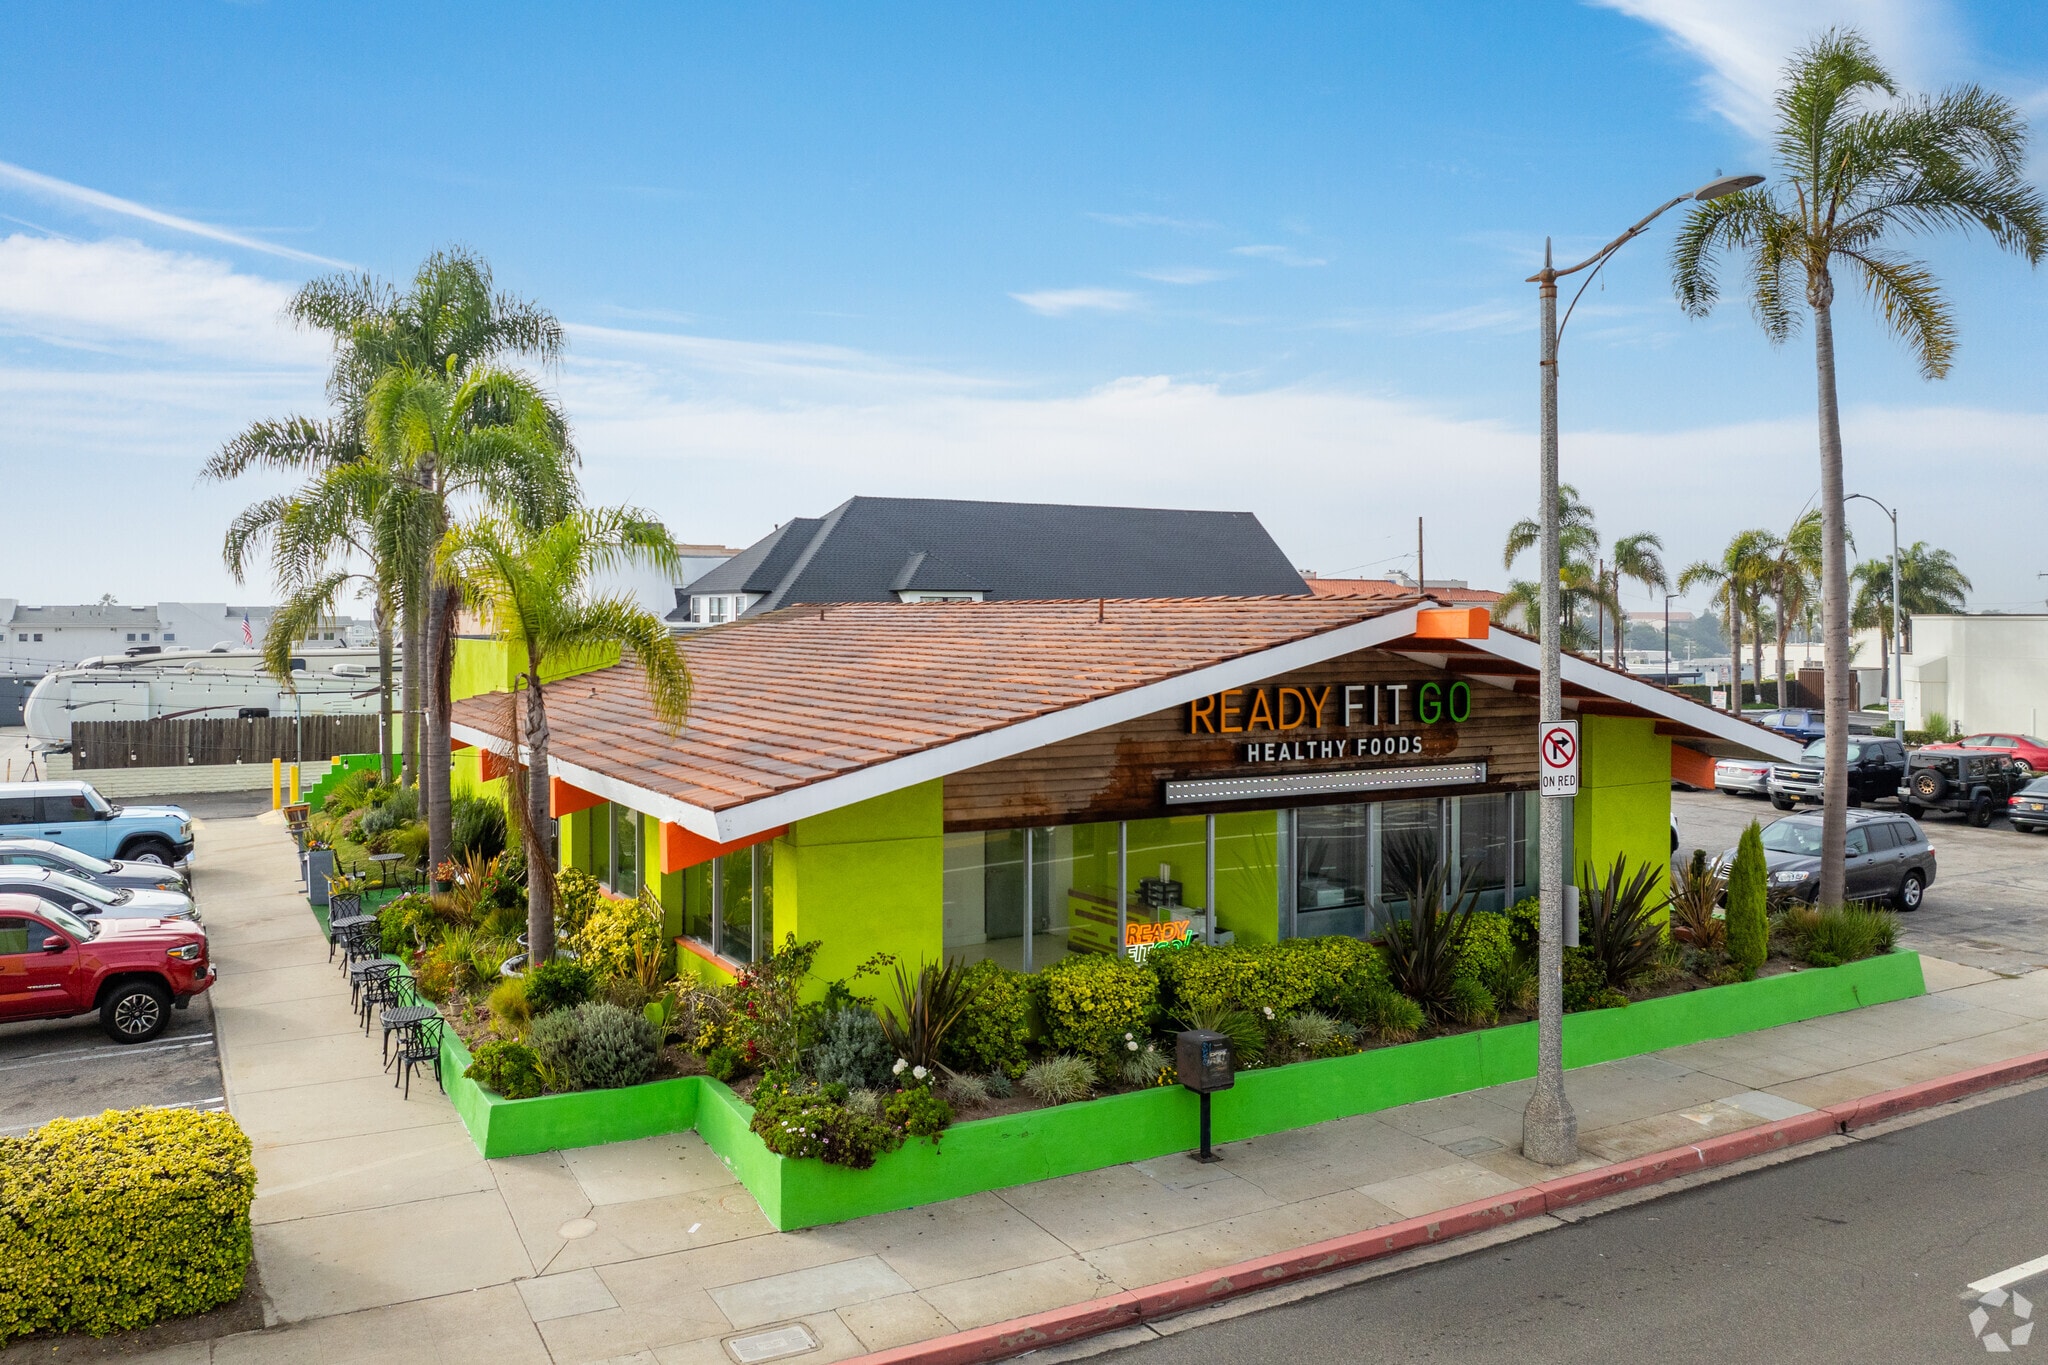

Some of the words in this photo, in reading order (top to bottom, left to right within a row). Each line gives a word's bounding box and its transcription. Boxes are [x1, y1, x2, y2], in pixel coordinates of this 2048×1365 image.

[1191, 687, 1331, 734] READY
[1344, 684, 1408, 727] FIT
[1418, 681, 1472, 725] GO
[1247, 739, 1347, 763] HEALTHY
[1357, 736, 1423, 757] FOODS
[1543, 776, 1555, 788] ON
[1558, 775, 1575, 787] RED
[1125, 920, 1190, 946] READY
